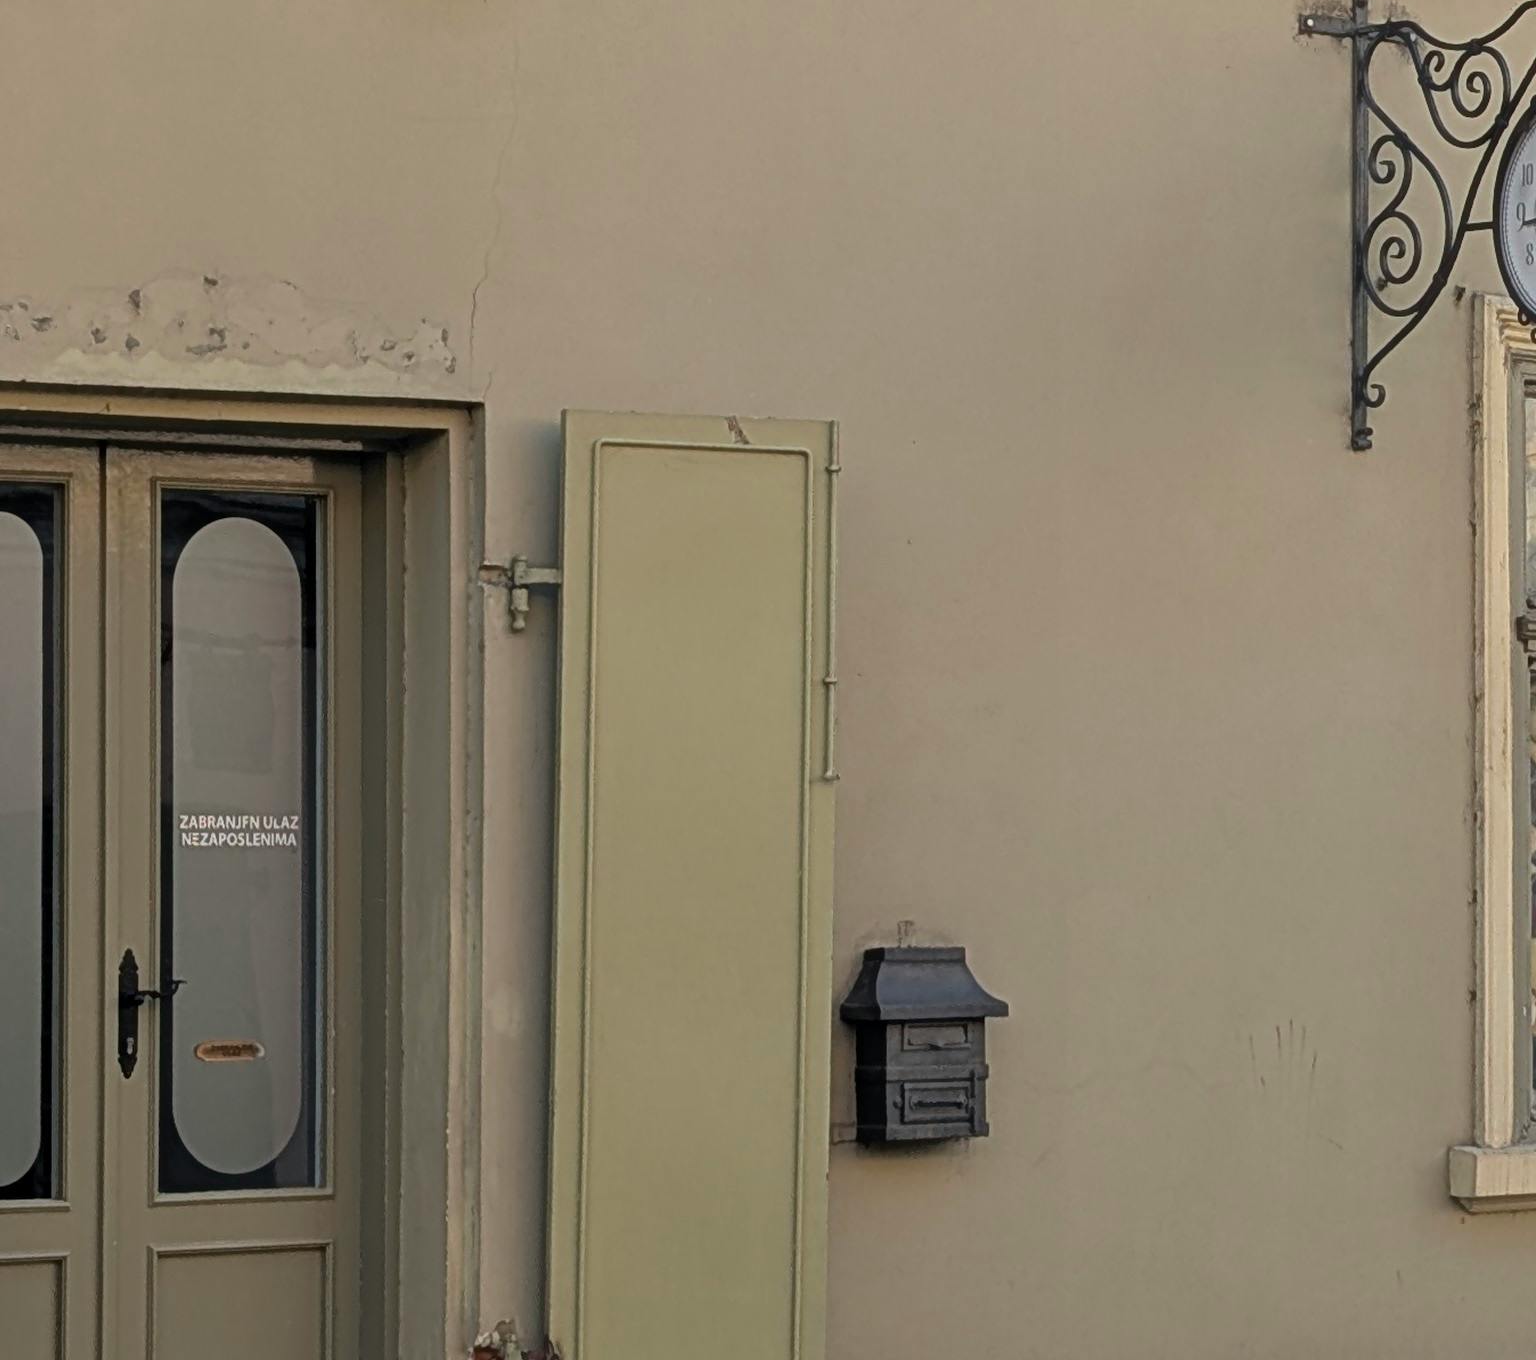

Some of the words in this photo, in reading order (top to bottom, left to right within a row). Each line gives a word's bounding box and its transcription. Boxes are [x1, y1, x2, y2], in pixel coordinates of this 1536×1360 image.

[1522, 163, 1534, 187] 10
[1516, 202, 1526, 232] 9
[1525, 242, 1534, 266] 8
[263, 815, 299, 830] ULAZ
[181, 832, 297, 847] NEZAPOSLENIMA
